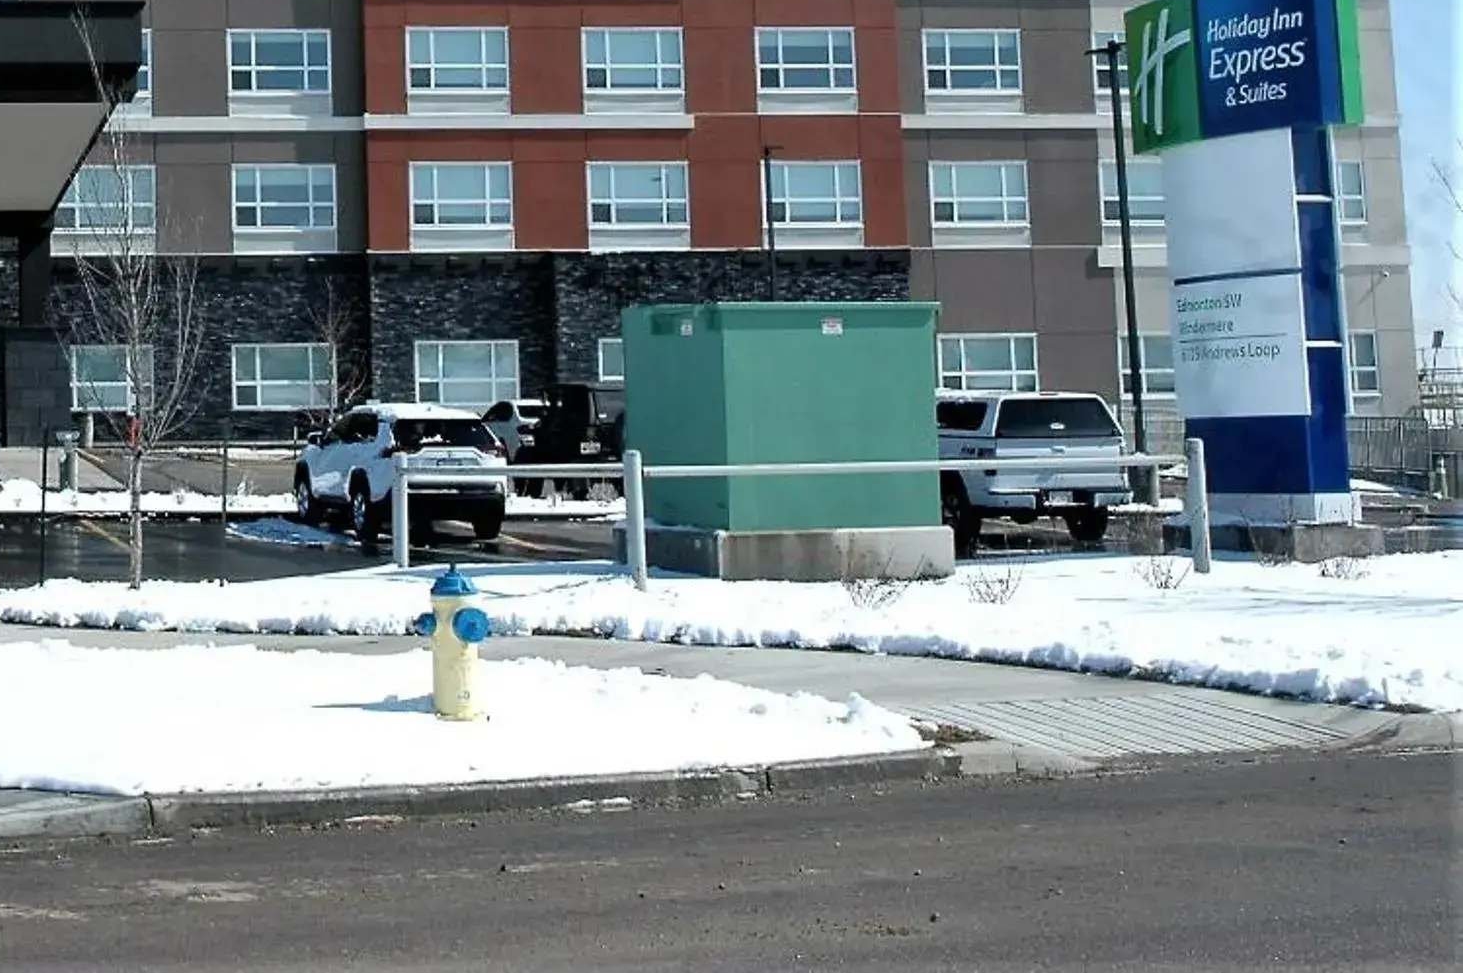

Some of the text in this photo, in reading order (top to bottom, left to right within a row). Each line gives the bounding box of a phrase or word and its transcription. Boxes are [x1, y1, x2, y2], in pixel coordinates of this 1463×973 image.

[1207, 6, 1303, 42] Holiday Inn
[1208, 41, 1306, 83] Express
[1225, 82, 1287, 106] & Suites
[1247, 342, 1280, 360] Loop
